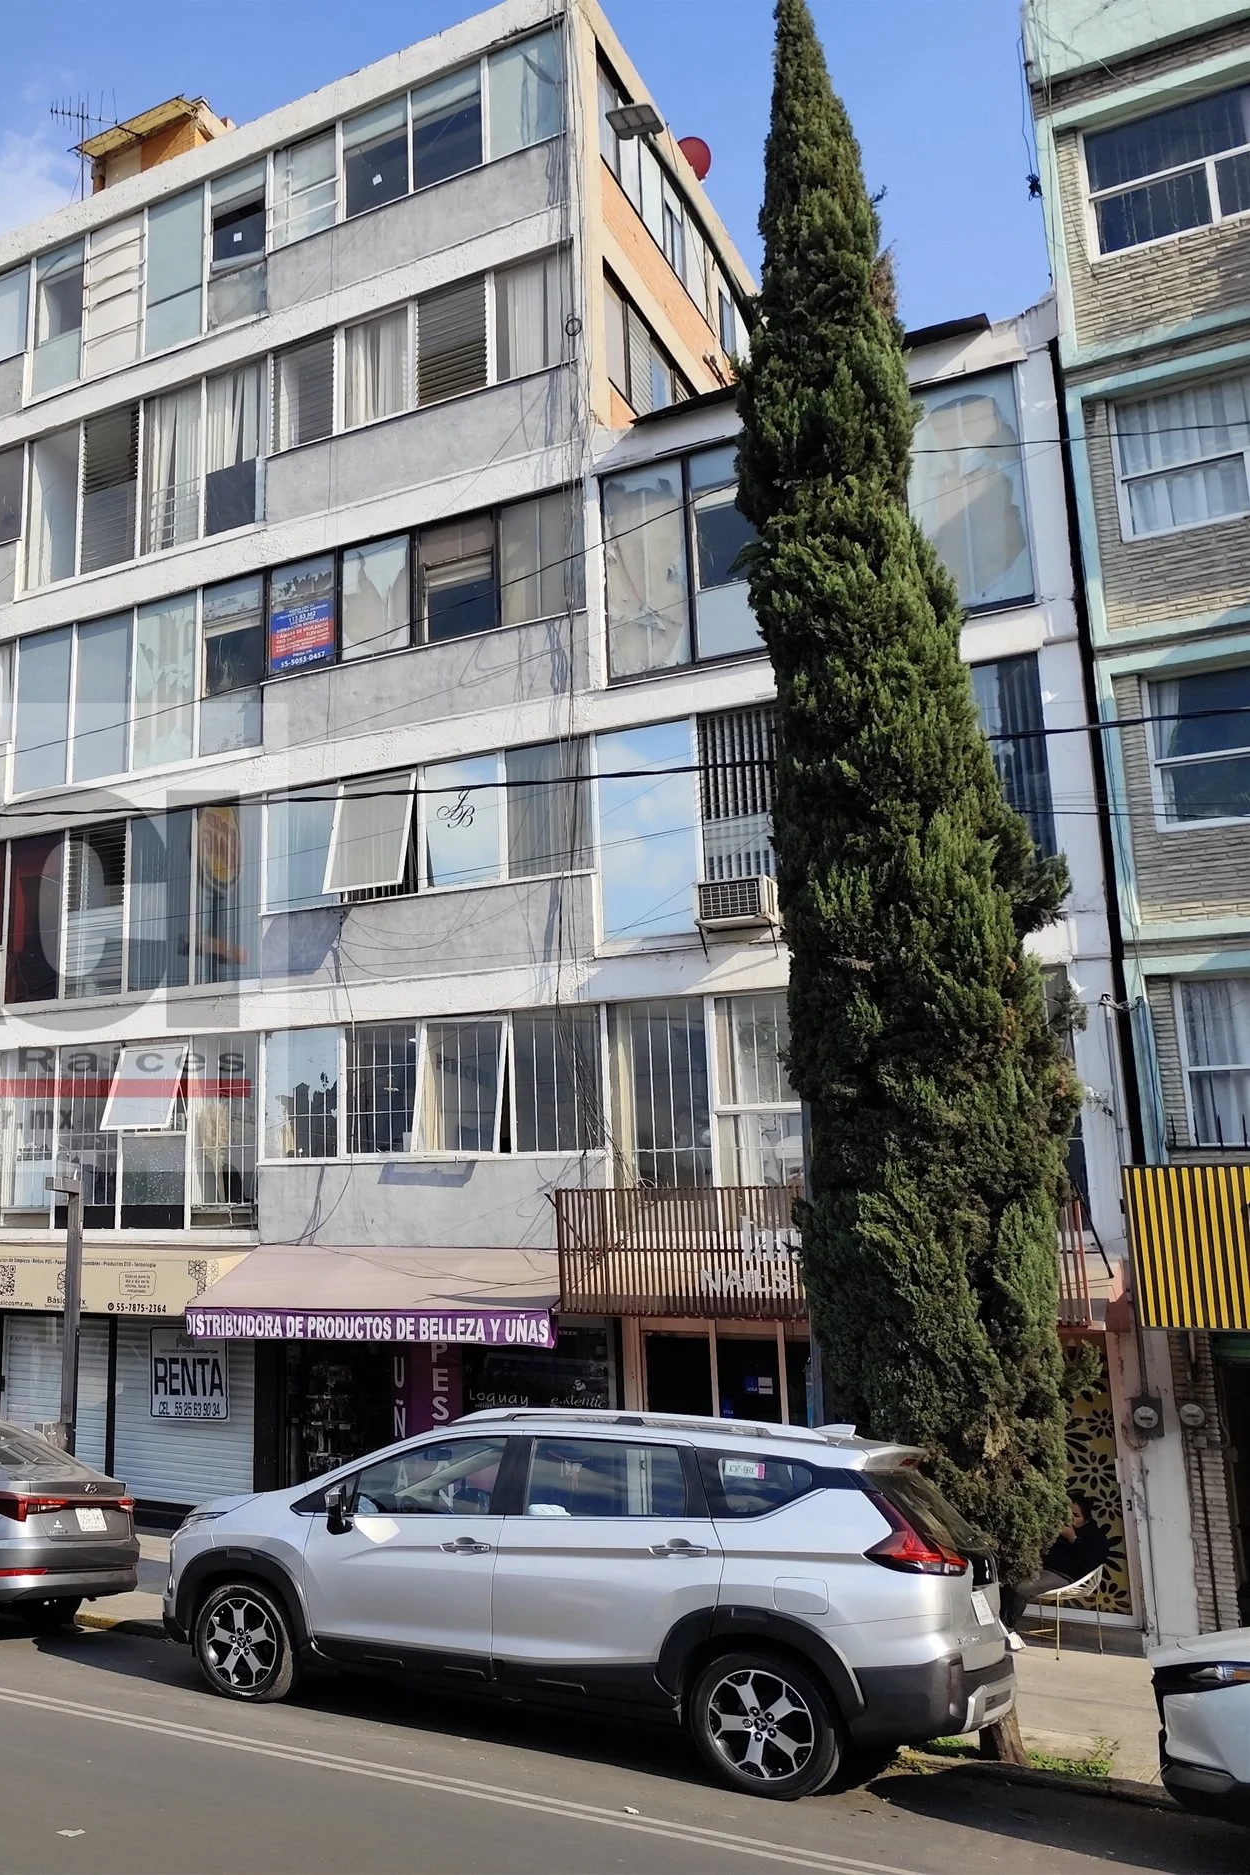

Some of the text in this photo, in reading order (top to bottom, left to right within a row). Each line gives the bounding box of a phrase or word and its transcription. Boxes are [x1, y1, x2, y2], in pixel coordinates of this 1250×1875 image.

[701, 1269, 791, 1293] NAILS
[116, 1303, 167, 1313] 55-7875-2364
[186, 1314, 549, 1343] DISTRIBUIDORA DE PRODUCTOS DE BELLEZA Y UÑAS
[154, 1357, 224, 1397] RENTA
